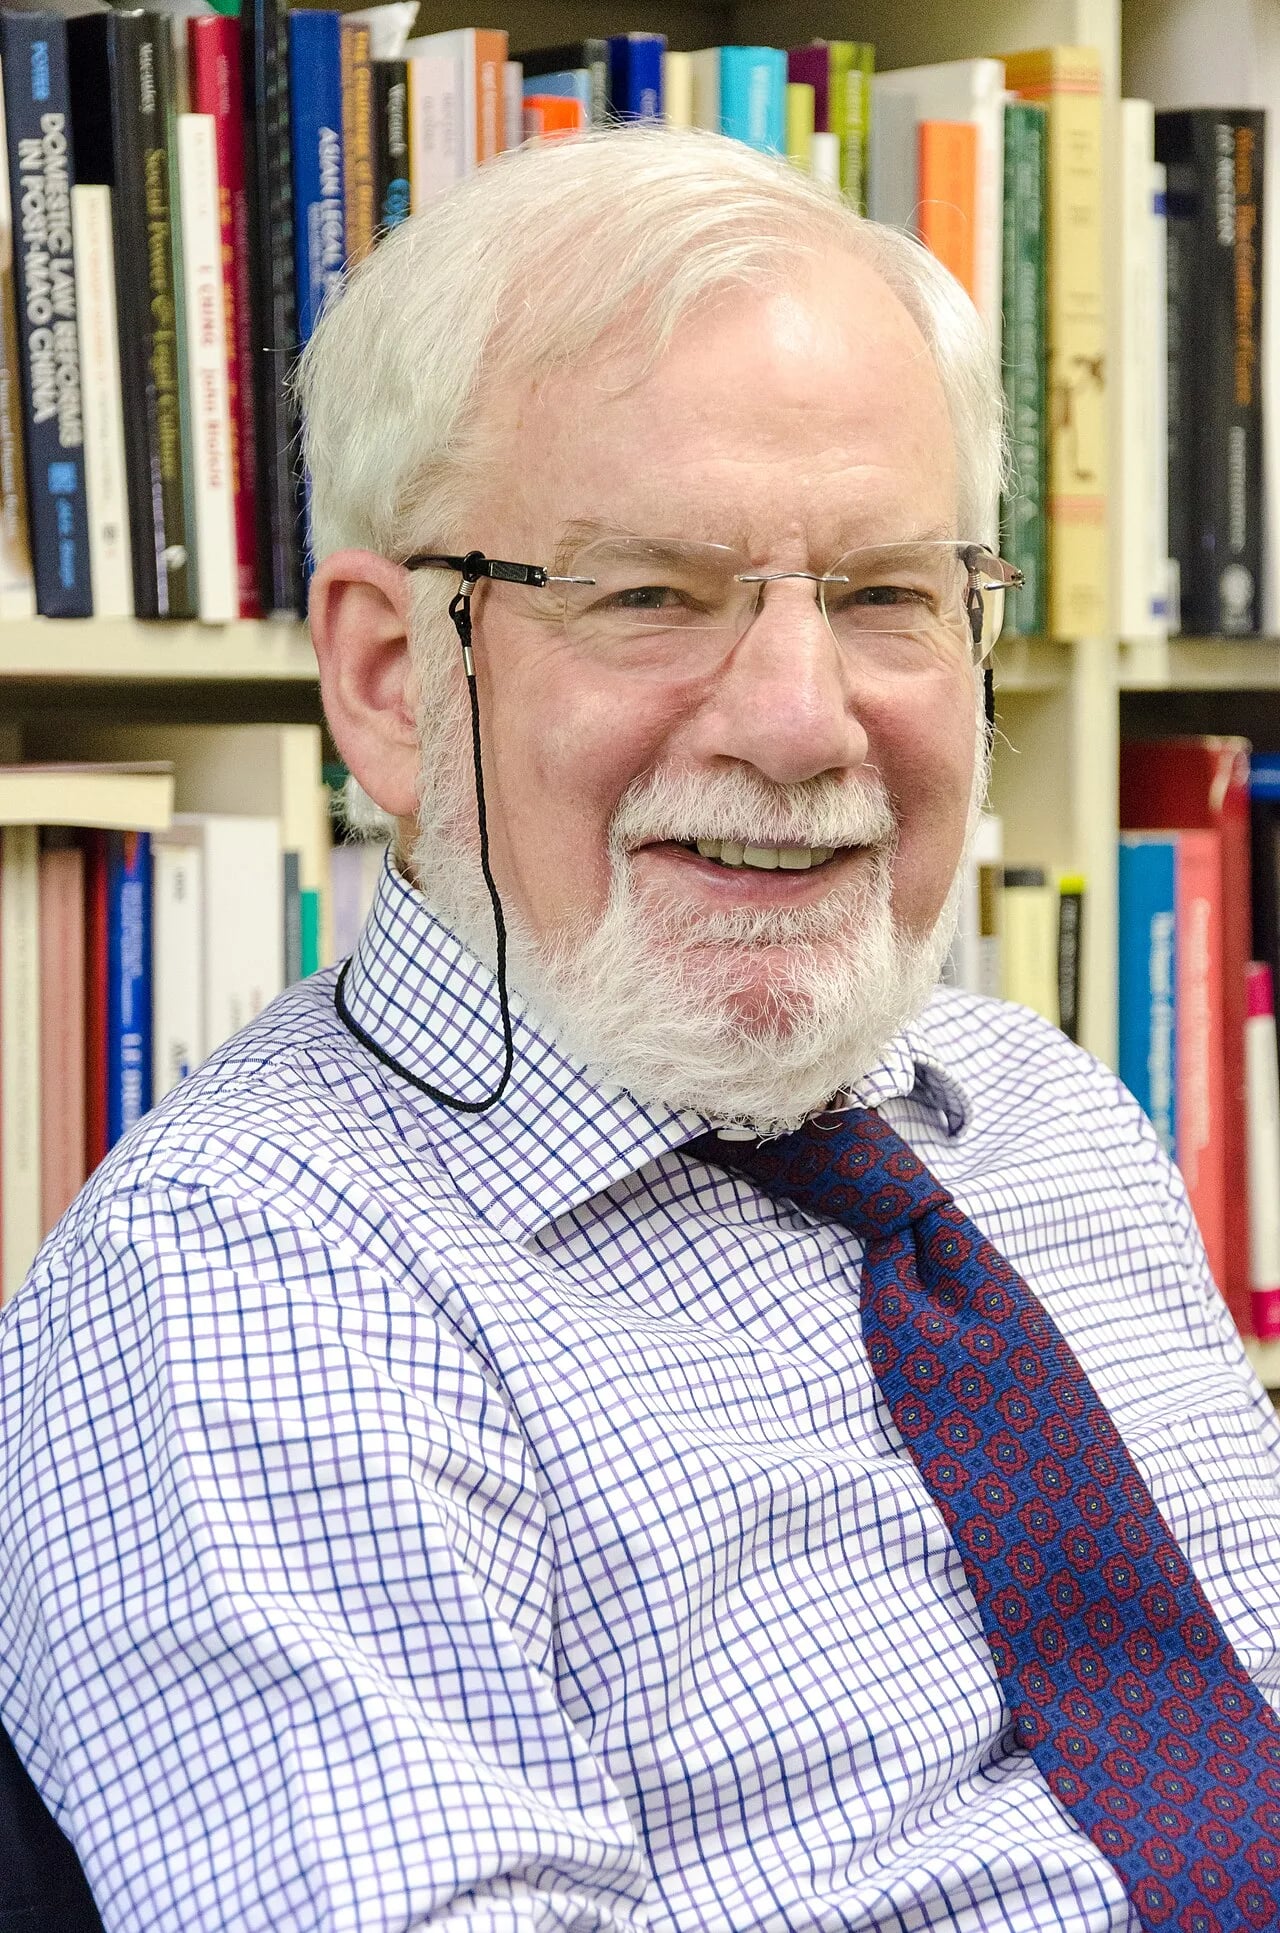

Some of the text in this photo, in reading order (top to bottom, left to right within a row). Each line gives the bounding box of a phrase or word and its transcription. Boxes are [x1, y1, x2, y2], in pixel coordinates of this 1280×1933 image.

[144, 149, 168, 215] Social
[318, 127, 341, 195] ASIAN
[147, 221, 170, 293] Power
[321, 199, 342, 266] LEGAL
[19, 139, 57, 424] IN POST-MAO CHINA
[41, 113, 83, 447] DOMESTIC LAW REFORMS
[148, 330, 176, 387] Legal
